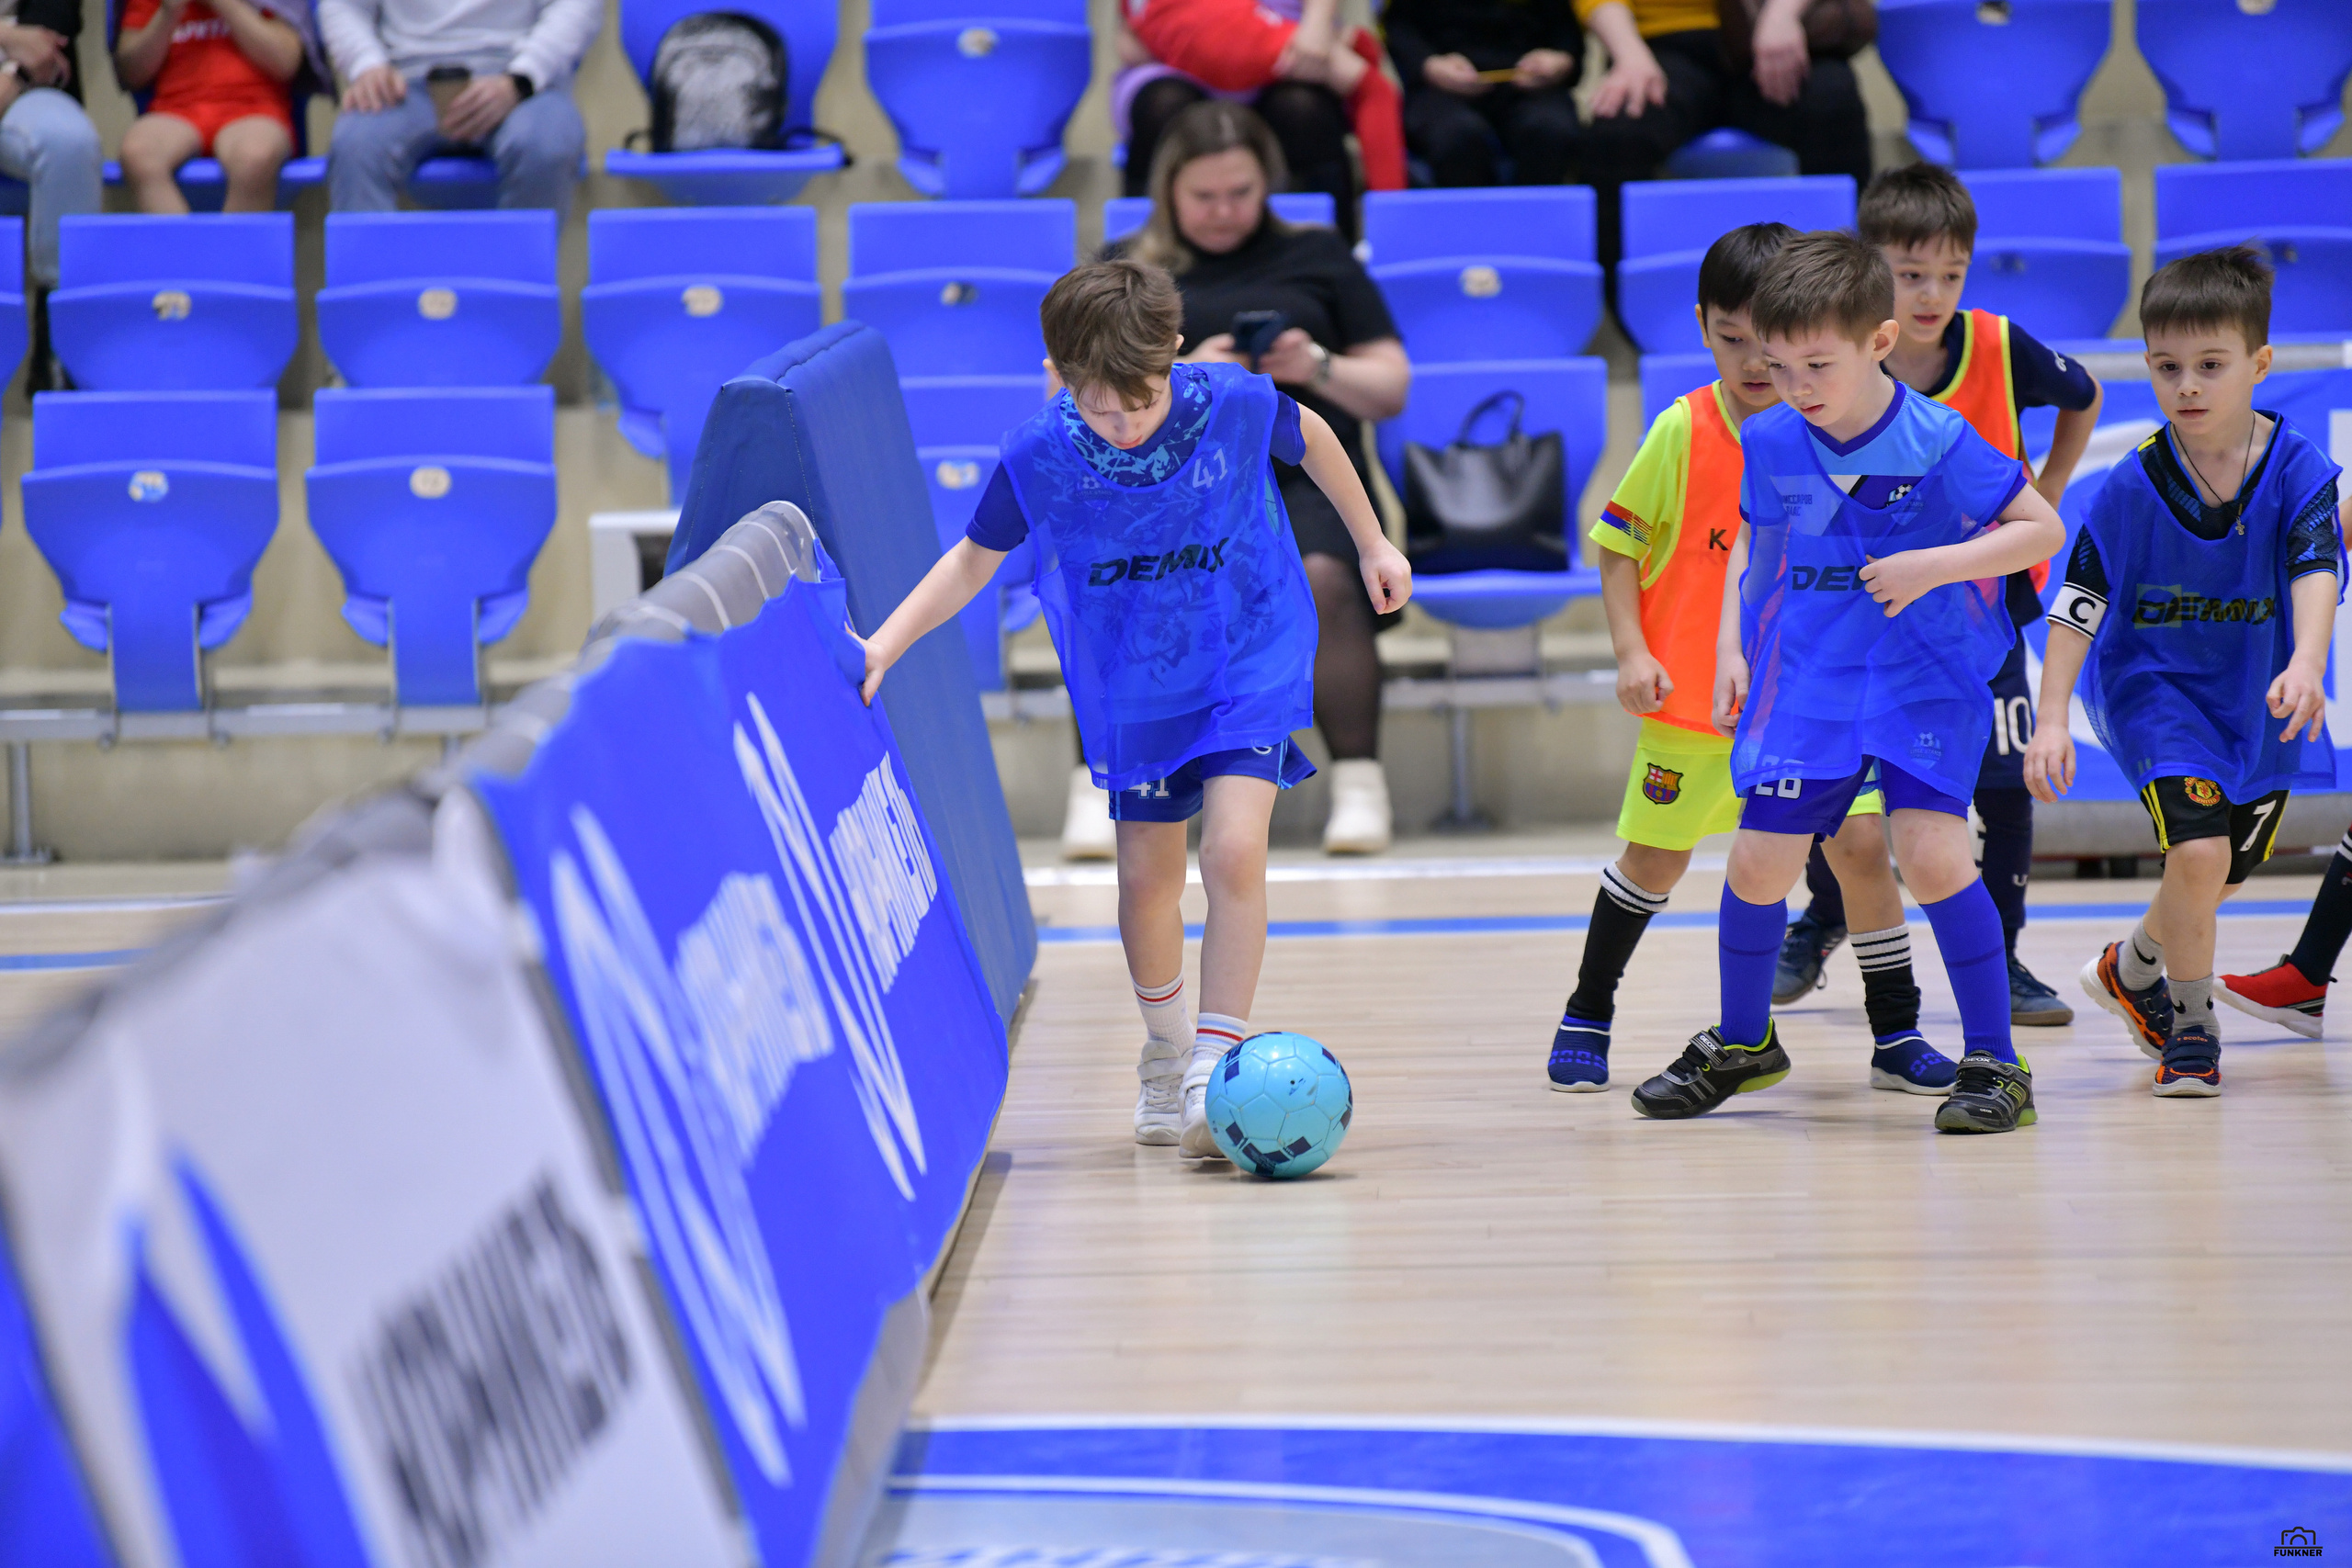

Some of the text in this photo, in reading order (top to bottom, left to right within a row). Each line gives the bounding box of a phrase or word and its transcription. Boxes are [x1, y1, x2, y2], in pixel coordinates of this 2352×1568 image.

[1192, 447, 1228, 489] 41
[1088, 536, 1230, 587] DEMIX
[2068, 596, 2098, 625] C
[1994, 695, 2033, 756] 10
[2196, 796, 2217, 805] UNITED
[2239, 799, 2277, 852] 7
[1698, 1034, 1718, 1053] GEOX
